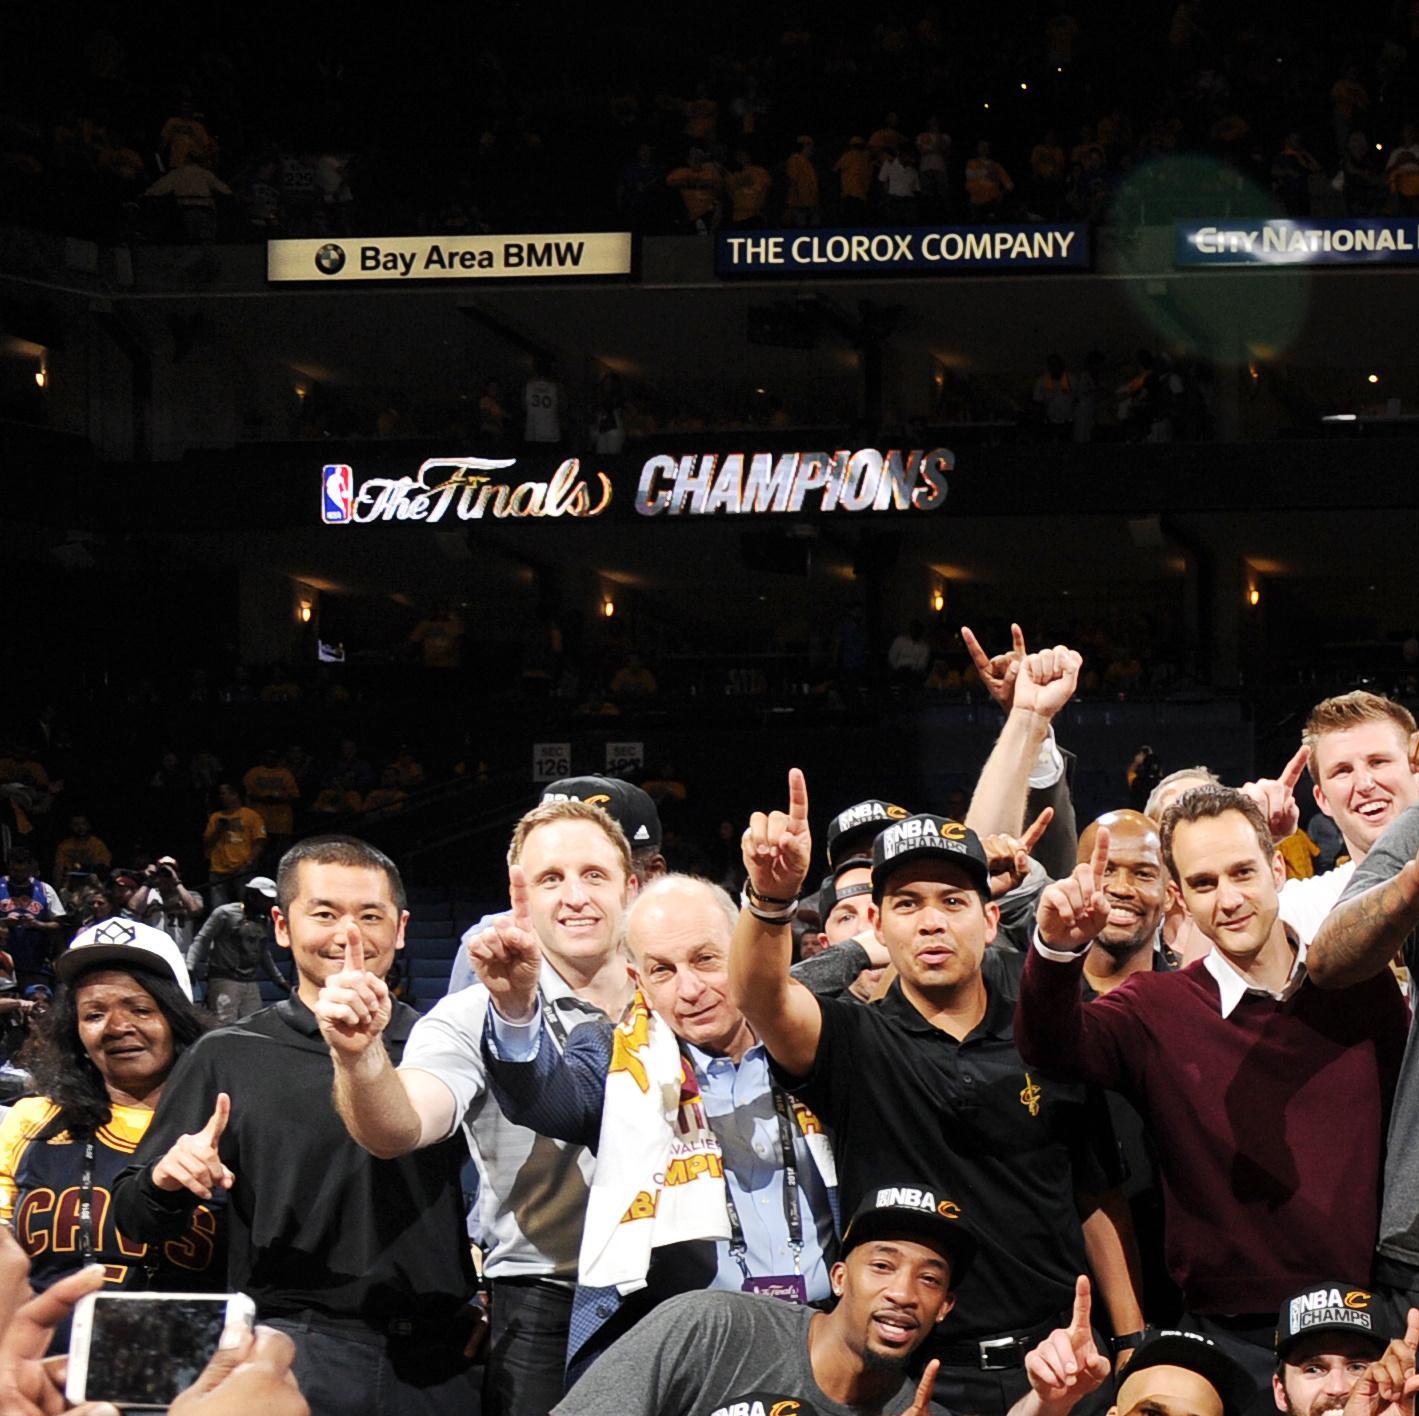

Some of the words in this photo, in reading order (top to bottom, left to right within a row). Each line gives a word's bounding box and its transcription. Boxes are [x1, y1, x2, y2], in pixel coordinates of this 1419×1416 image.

[727, 238, 784, 264] THE
[791, 234, 914, 263] CLOROX
[922, 231, 1075, 261] COMPANY
[1263, 226, 1413, 253] NATIONAL
[360, 246, 416, 276] Bay
[424, 244, 494, 270] Area
[503, 241, 584, 267] BMW
[354, 476, 429, 522] The
[417, 456, 613, 523] Finals
[635, 447, 955, 516] CHAMPIONS
[536, 760, 568, 776] 126
[845, 803, 886, 822] NBA
[893, 818, 932, 839] NBA
[895, 838, 967, 858] CHAMPS
[889, 1187, 938, 1218] NBA
[1300, 1288, 1345, 1313] NBA
[1301, 1308, 1372, 1331] CHAMPS
